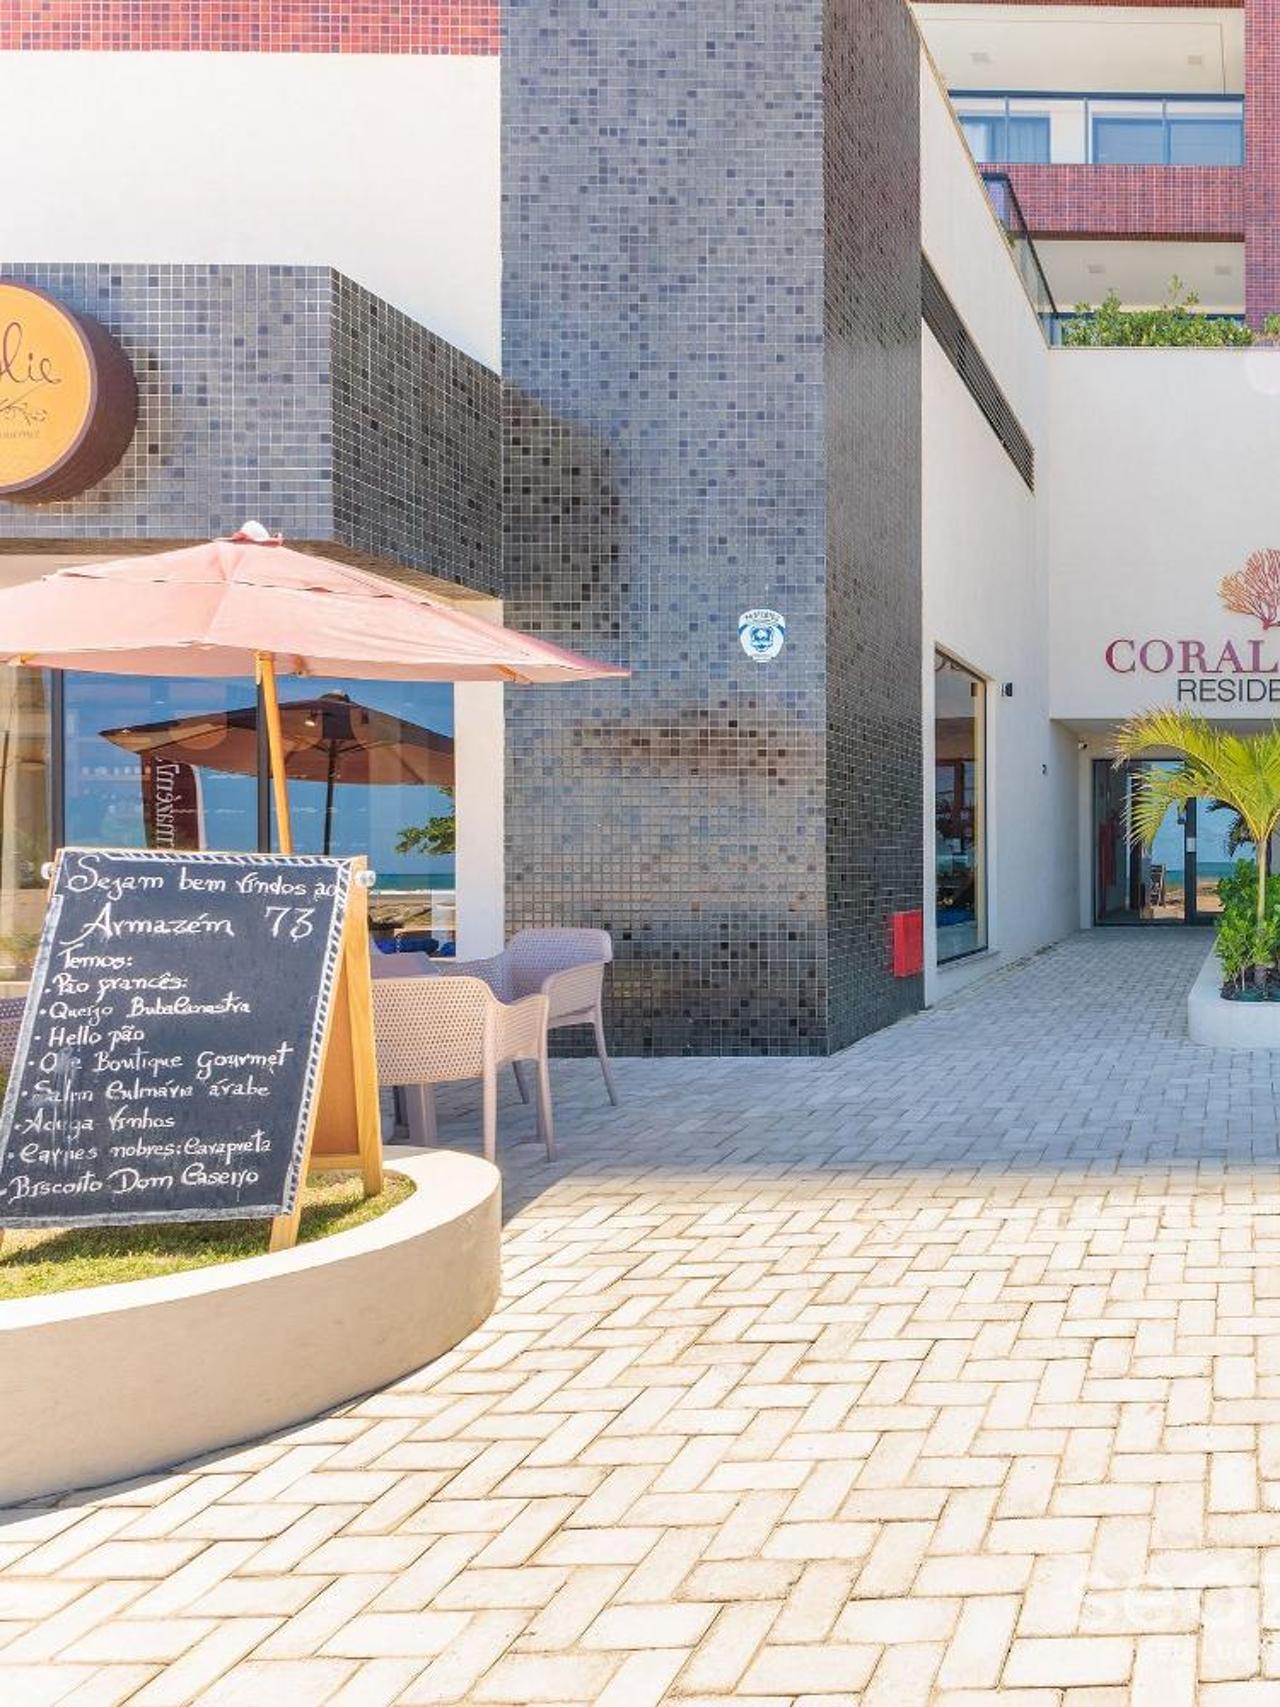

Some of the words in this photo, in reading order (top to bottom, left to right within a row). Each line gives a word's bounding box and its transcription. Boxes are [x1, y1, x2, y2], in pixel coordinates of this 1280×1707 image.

[0, 322, 62, 384] lie
[1105, 640, 1279, 673] CORAL
[66, 856, 164, 900] Sejam
[179, 866, 226, 893] bem
[60, 902, 235, 945] Armazém
[264, 905, 316, 942] 73
[52, 973, 89, 996] Pão
[49, 1002, 113, 1025] Queijo
[48, 1025, 102, 1047] Hello
[108, 1025, 145, 1051] pão
[92, 1047, 183, 1077] Boutique
[208, 1074, 271, 1098] árabe
[108, 1104, 176, 1132] Vinhos
[108, 1168, 174, 1194] Dom
[180, 1162, 259, 1188] Caseiro
